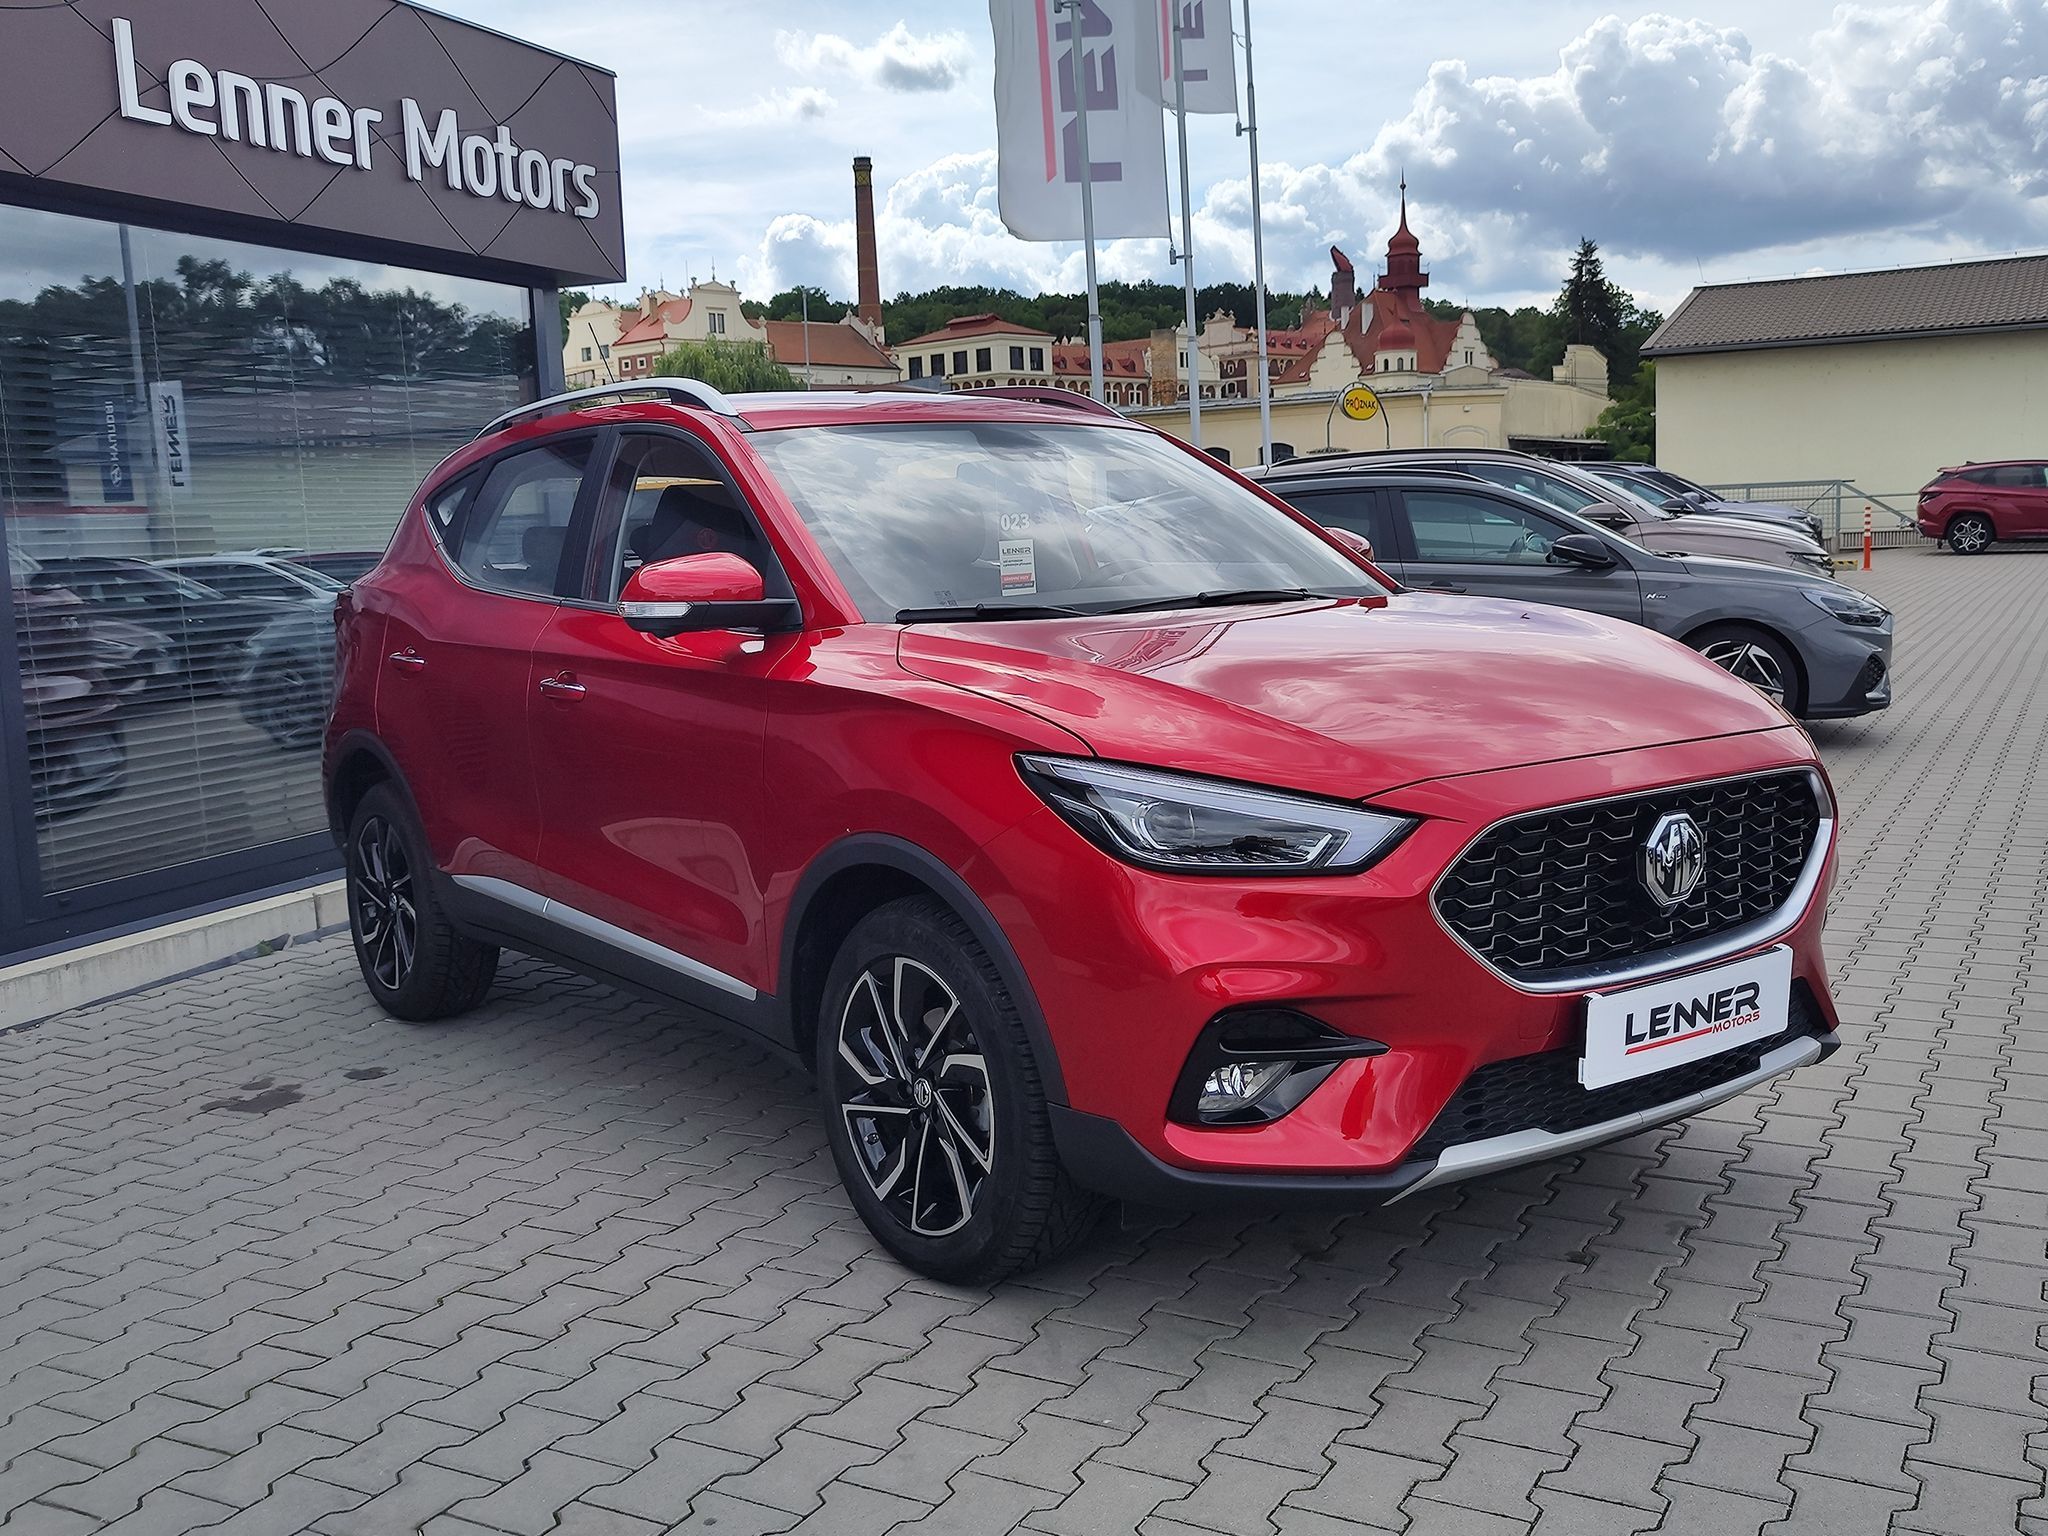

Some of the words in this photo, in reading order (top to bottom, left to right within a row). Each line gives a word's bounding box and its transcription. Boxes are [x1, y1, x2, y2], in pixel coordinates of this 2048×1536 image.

[111, 17, 383, 171] Lenner
[401, 98, 601, 220] Motors
[1000, 513, 1030, 531] 023
[1625, 981, 1760, 1045] LENNER
[1712, 1011, 1760, 1034] MOTORS
